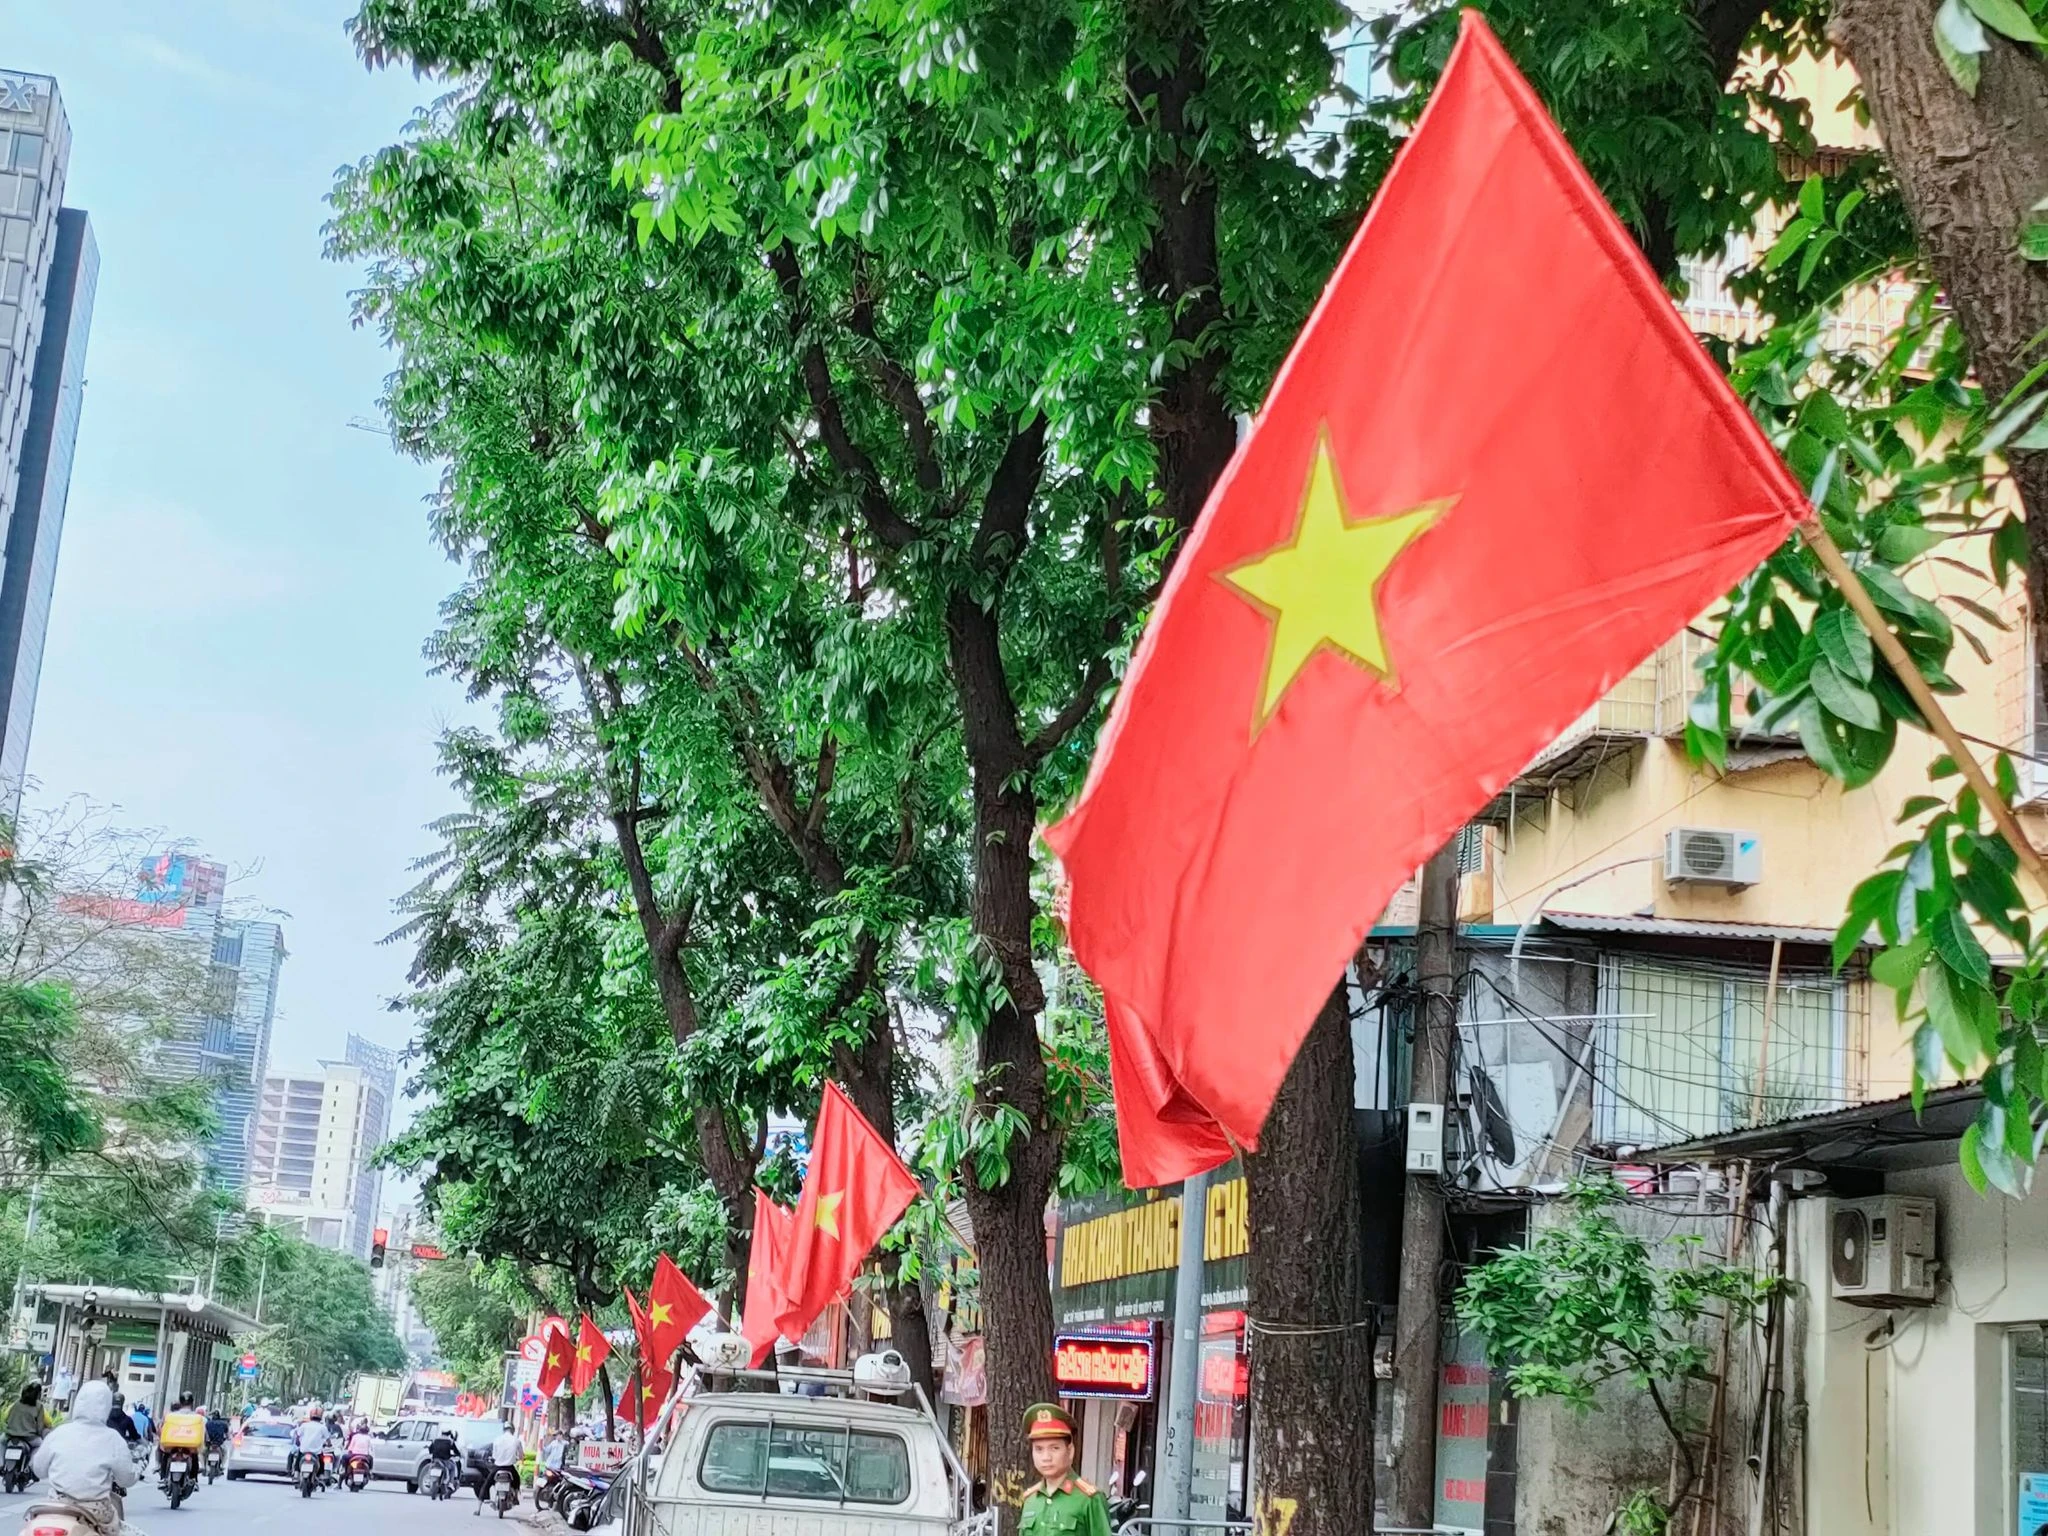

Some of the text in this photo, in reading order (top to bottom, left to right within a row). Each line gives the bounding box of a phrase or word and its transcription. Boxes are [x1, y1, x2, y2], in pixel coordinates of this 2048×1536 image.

[1087, 1211, 1123, 1283] KHOA
[1057, 1345, 1091, 1381] RĂNG
[583, 1446, 600, 1458] MUA
